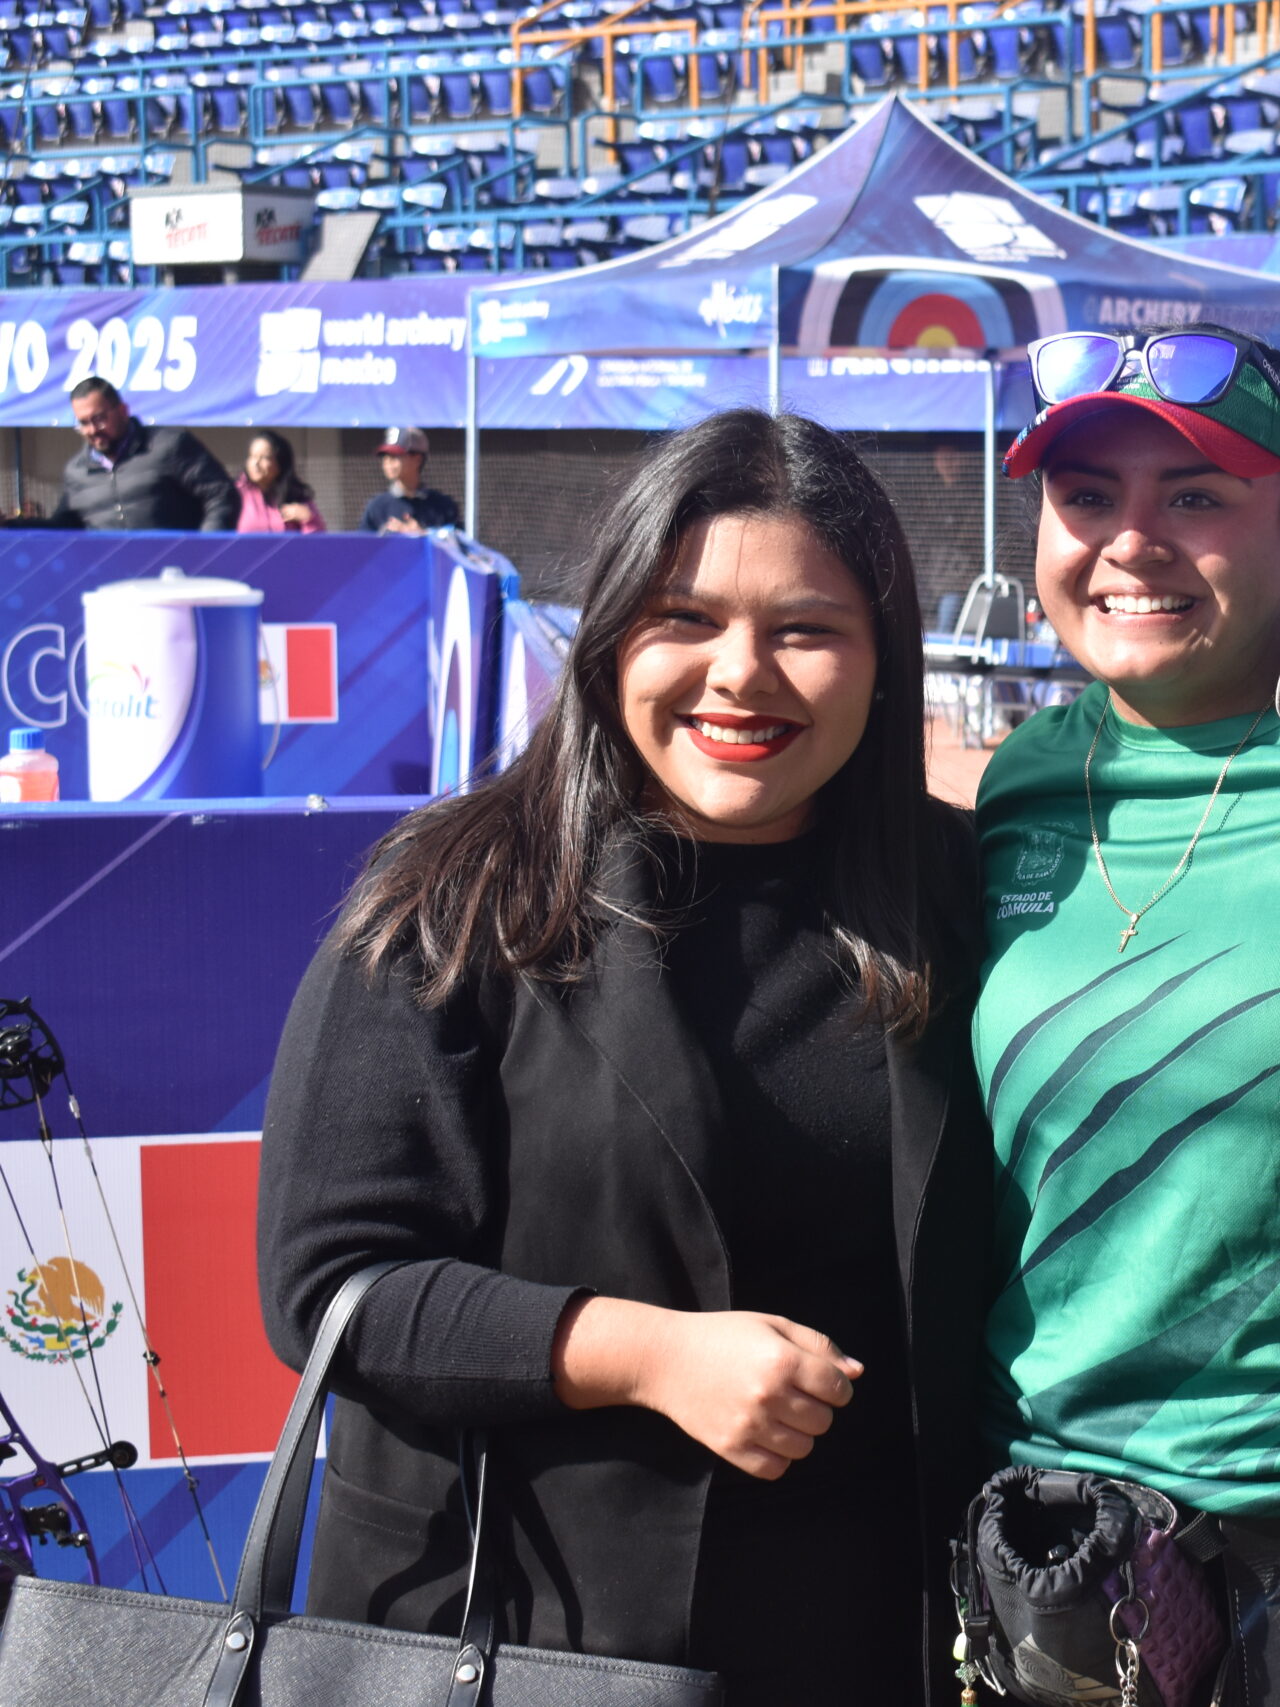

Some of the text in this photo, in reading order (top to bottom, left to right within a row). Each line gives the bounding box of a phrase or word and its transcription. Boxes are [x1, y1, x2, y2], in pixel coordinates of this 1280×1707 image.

[323, 312, 385, 346] world
[63, 316, 198, 392] 2025
[2, 623, 88, 729] C
[997, 901, 1055, 920] COAHUILA
[1000, 891, 1053, 904] ESTADO DE
